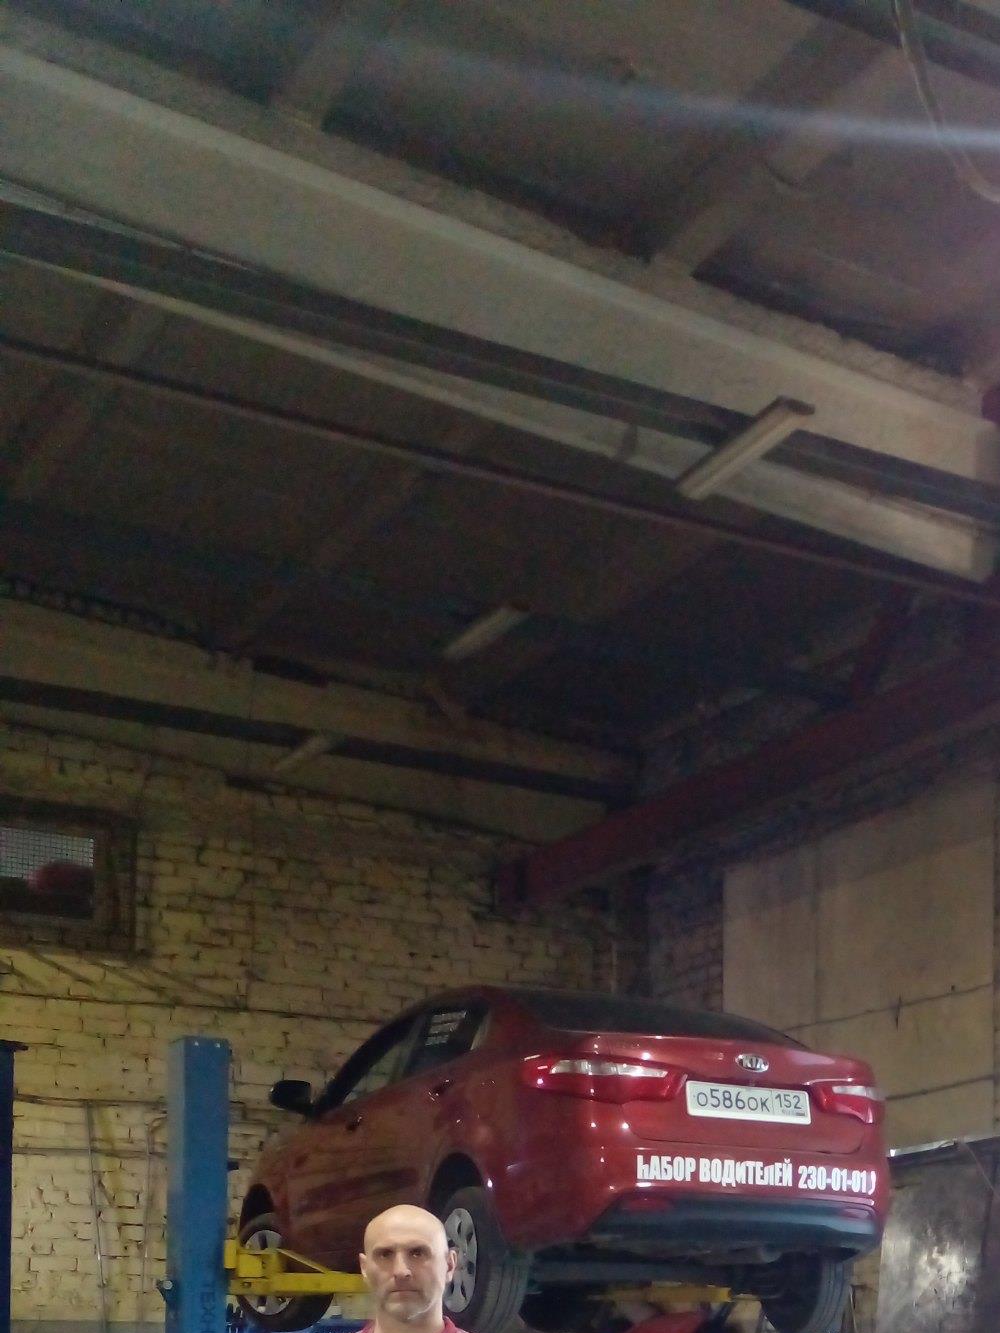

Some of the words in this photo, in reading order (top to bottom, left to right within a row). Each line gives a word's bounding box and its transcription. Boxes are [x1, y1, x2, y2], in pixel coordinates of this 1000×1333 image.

[742, 1055, 765, 1070] KIA
[775, 1093, 803, 1110] 152
[700, 1158, 793, 1187] ВОДИТЕЛЕЙ
